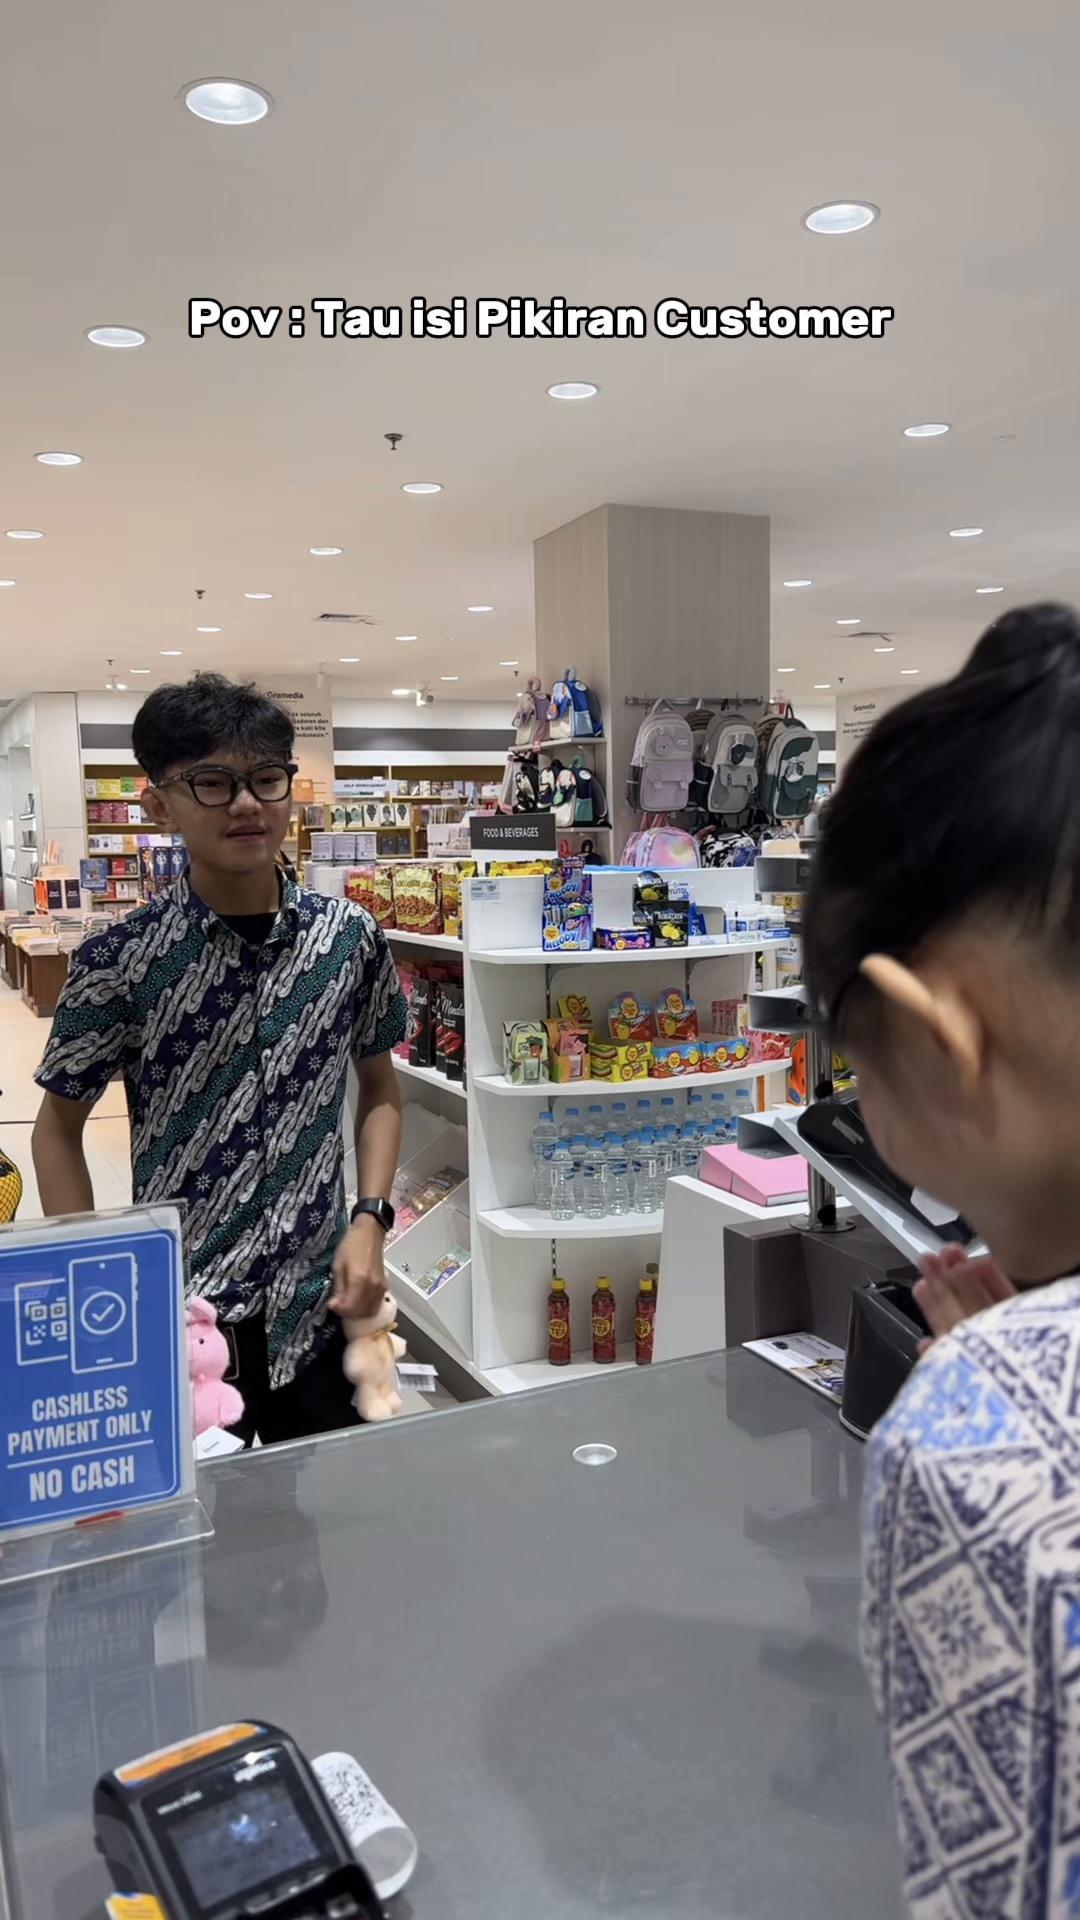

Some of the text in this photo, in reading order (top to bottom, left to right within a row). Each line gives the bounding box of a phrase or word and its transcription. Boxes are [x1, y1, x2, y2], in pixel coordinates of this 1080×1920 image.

[483, 828, 499, 838] FOOD
[505, 827, 539, 838] BEVERAGES
[31, 1385, 129, 1422] CASHLESS
[7, 1409, 153, 1456] PAYMENT ONLY
[29, 1455, 135, 1502] NO CASH
